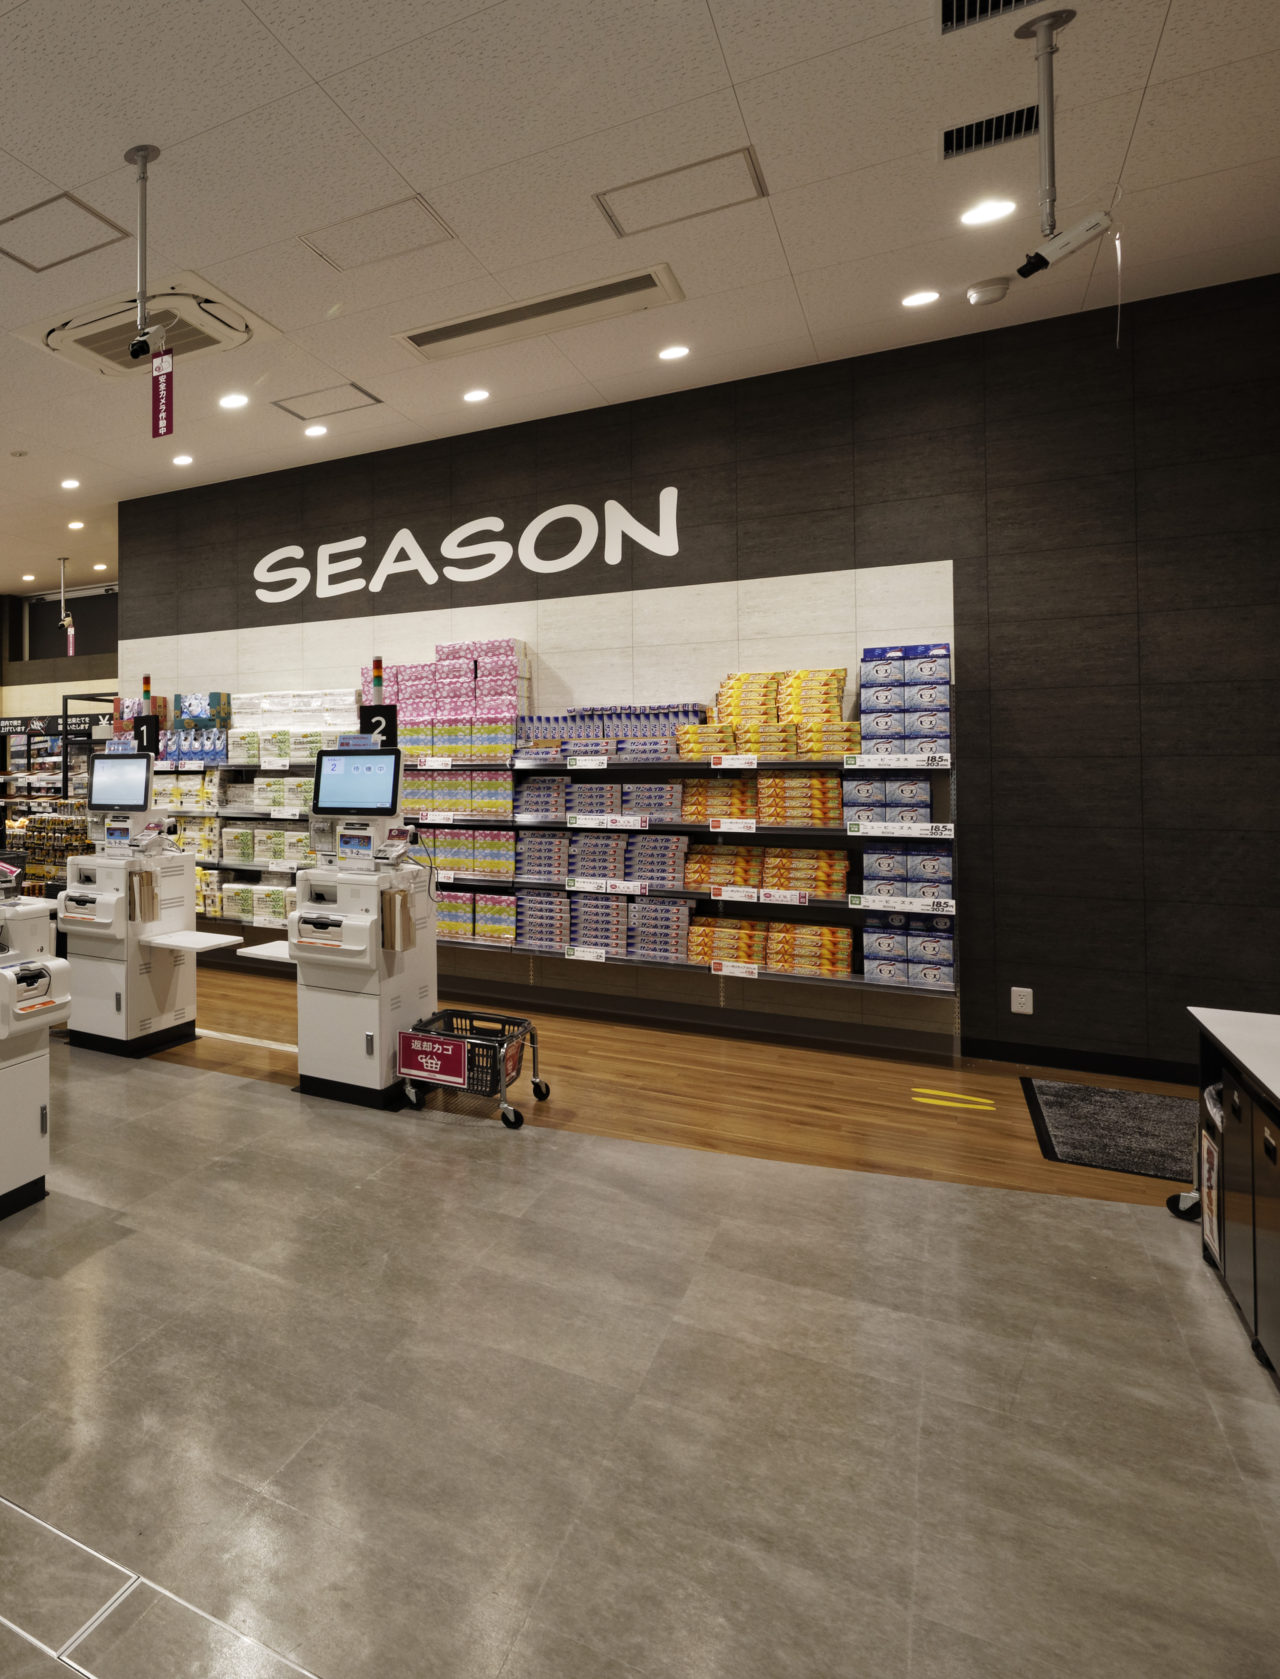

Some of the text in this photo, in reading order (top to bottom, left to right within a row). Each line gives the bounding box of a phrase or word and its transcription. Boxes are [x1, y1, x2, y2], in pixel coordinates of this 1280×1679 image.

[158, 374, 166, 434] 安全カメラ作動中
[253, 486, 679, 603] SEASON
[140, 725, 147, 746] 1
[370, 716, 386, 740] 2
[331, 763, 337, 772] 2
[411, 1039, 454, 1055] 返却カゴ
